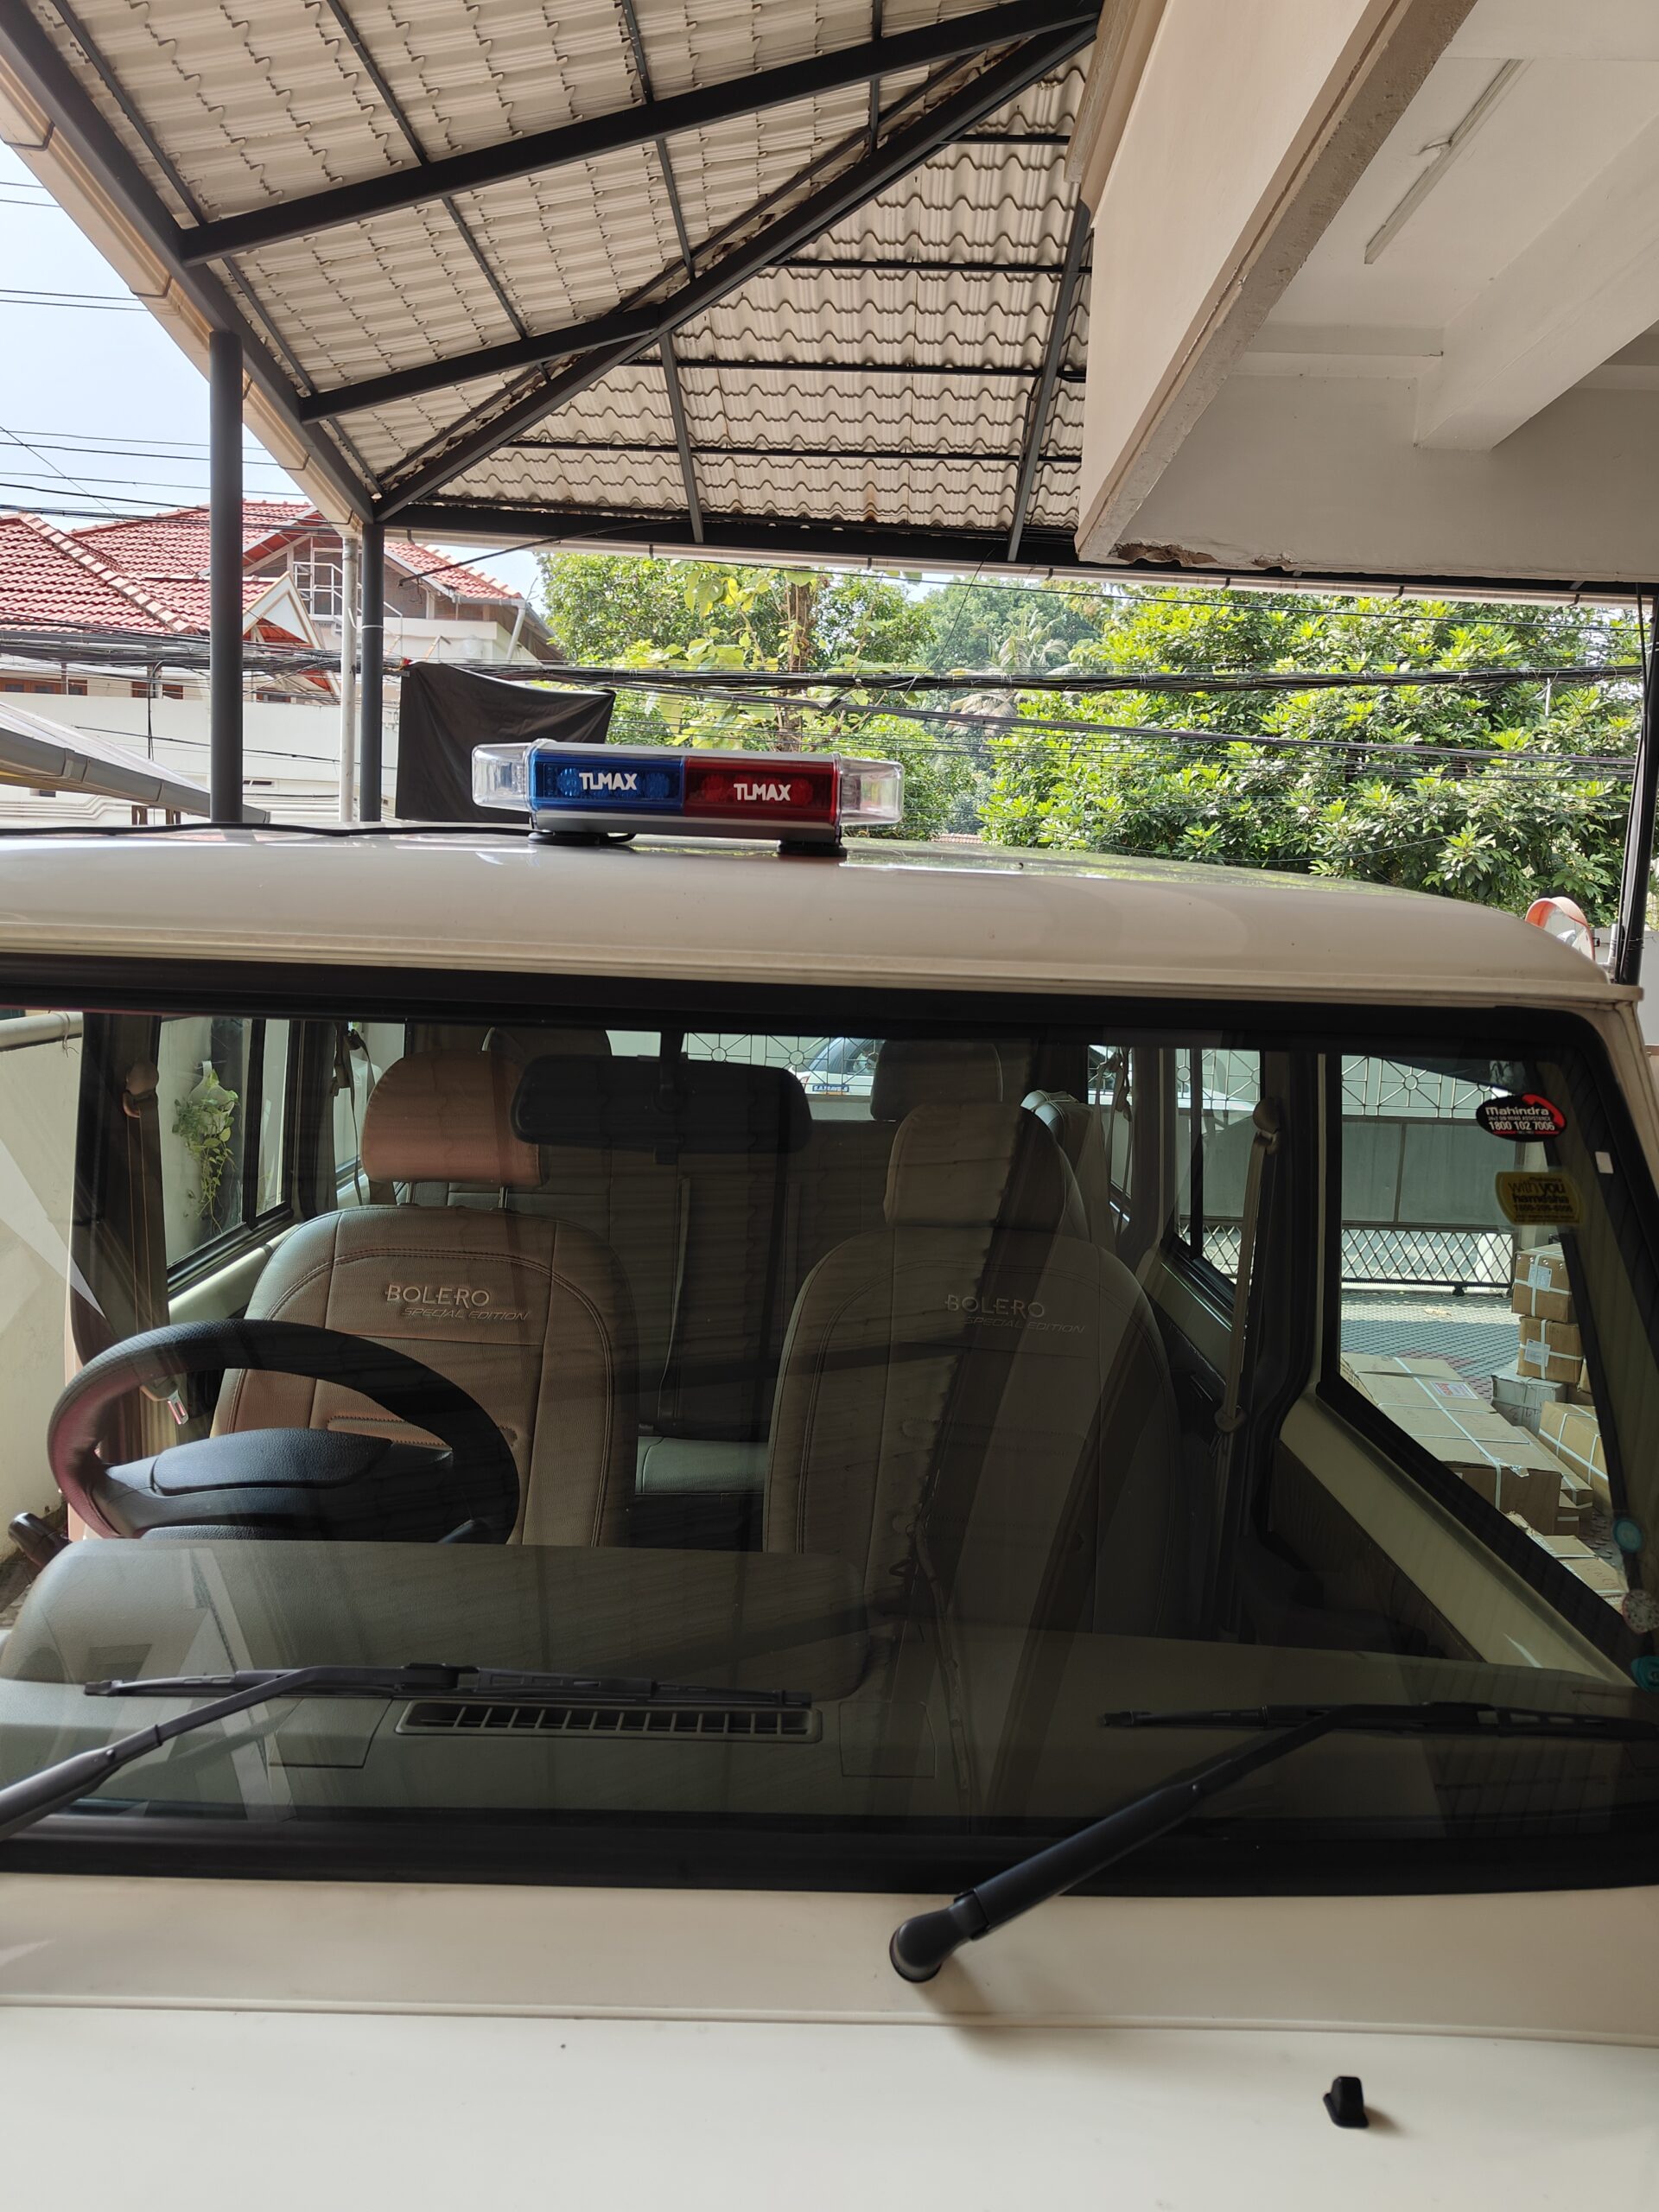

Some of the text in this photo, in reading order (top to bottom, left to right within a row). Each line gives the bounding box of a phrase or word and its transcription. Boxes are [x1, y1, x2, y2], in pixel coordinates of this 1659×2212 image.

[579, 772, 638, 791] TLMAX
[734, 784, 791, 802] TLMAX
[1489, 1122, 1556, 1131] 1800 102 7006
[1508, 1179, 1566, 1196] with you
[385, 1284, 491, 1309] BOLERO
[404, 1307, 530, 1321] SPECIAL EDITION
[944, 1294, 1046, 1319] BOLERO
[965, 1316, 1085, 1333] SPECIAL EDITION
